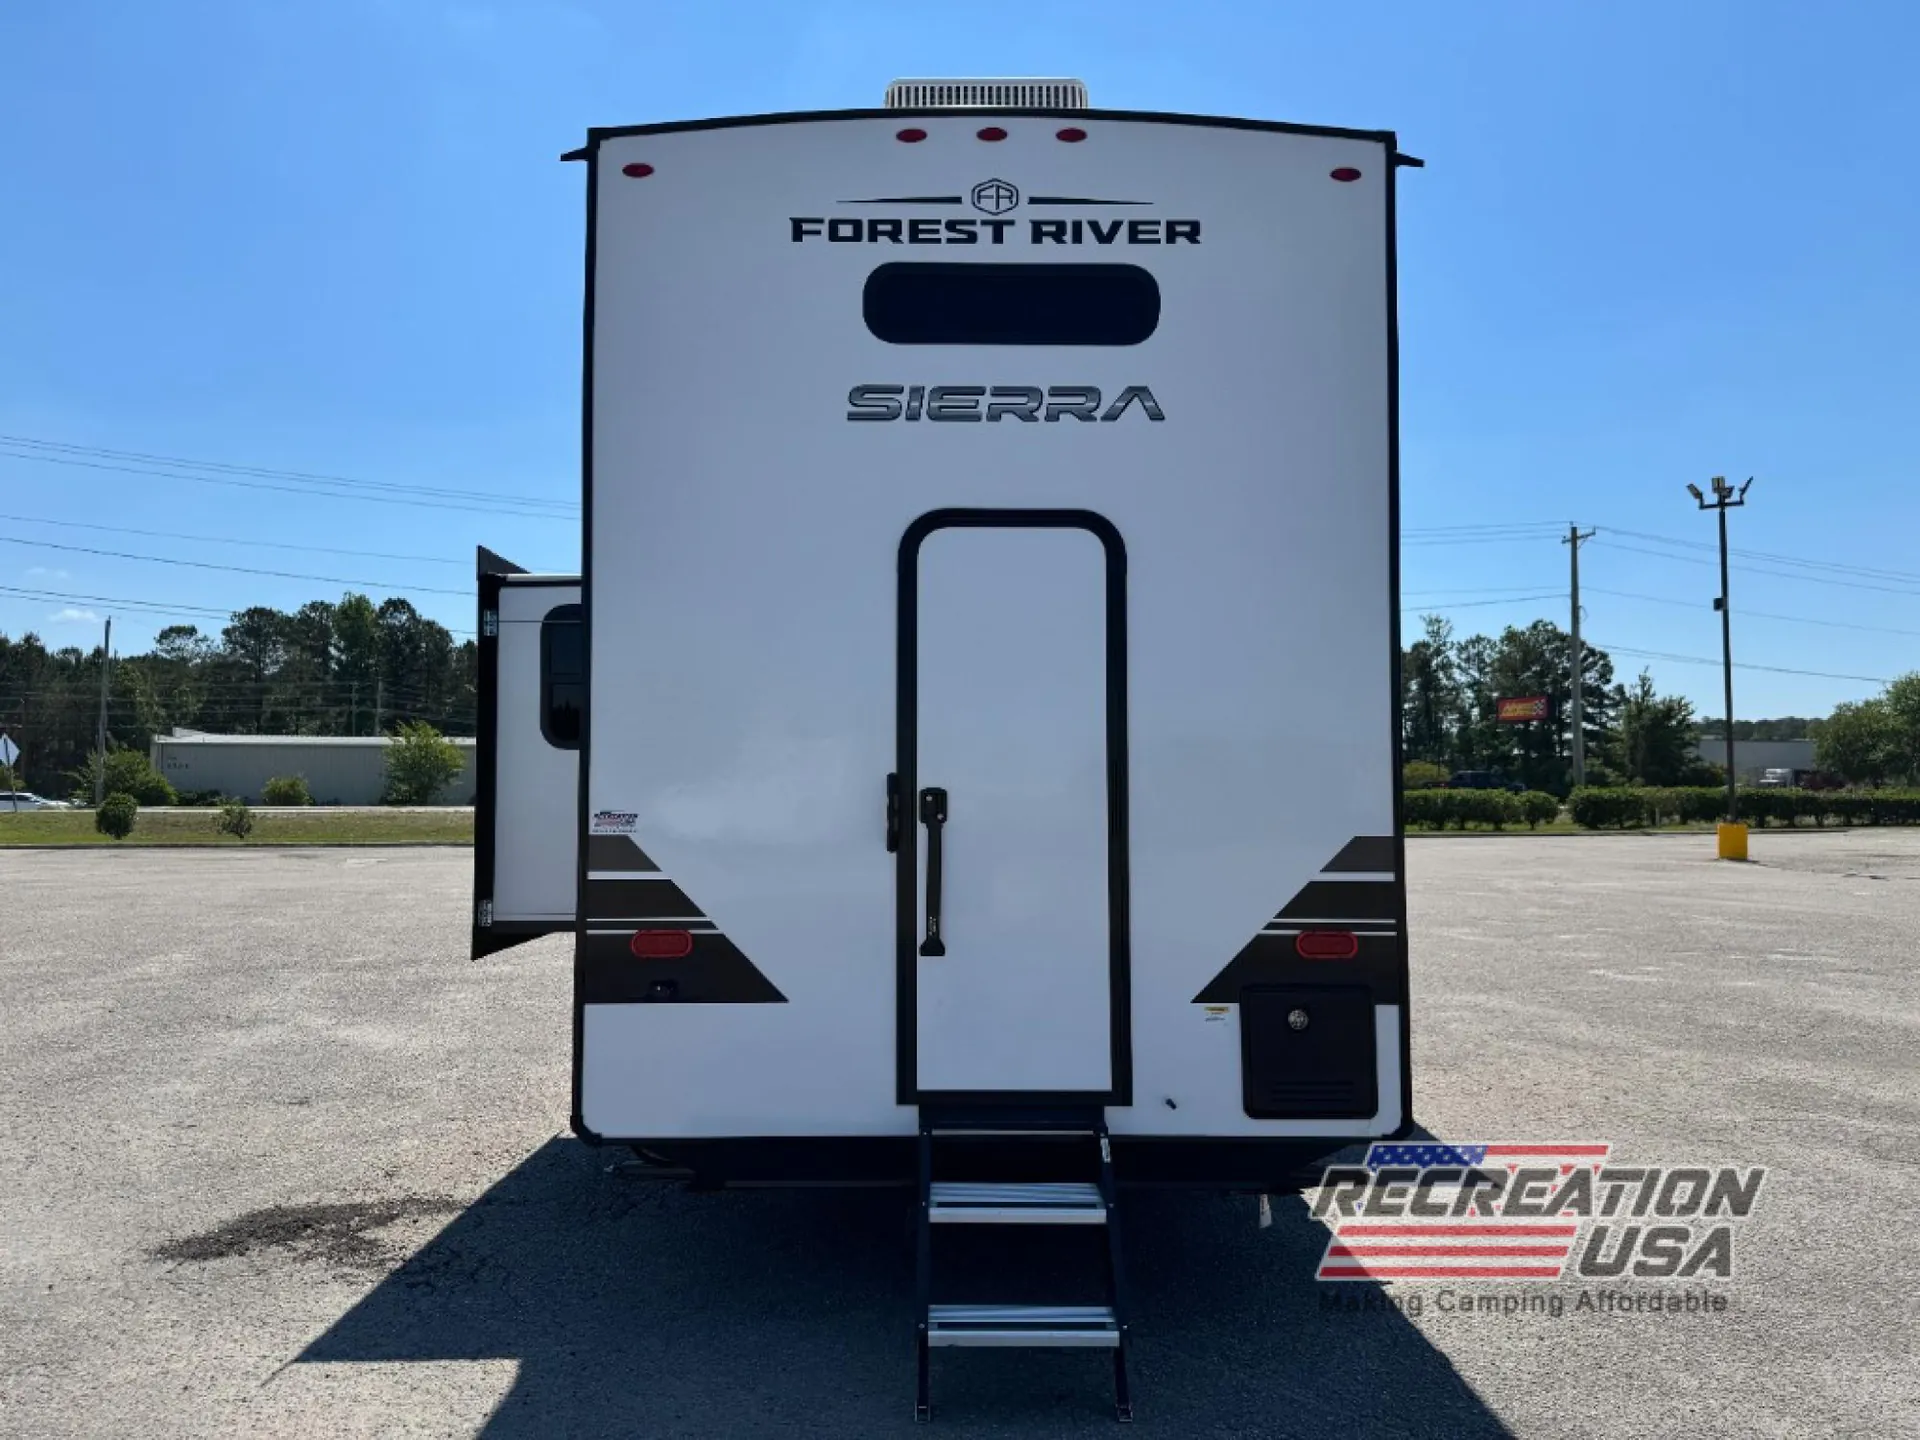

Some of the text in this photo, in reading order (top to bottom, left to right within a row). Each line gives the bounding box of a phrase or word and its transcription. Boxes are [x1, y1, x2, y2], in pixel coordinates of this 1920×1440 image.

[789, 217, 1202, 245] FOREST RIVER
[847, 384, 1165, 422] SIERRA
